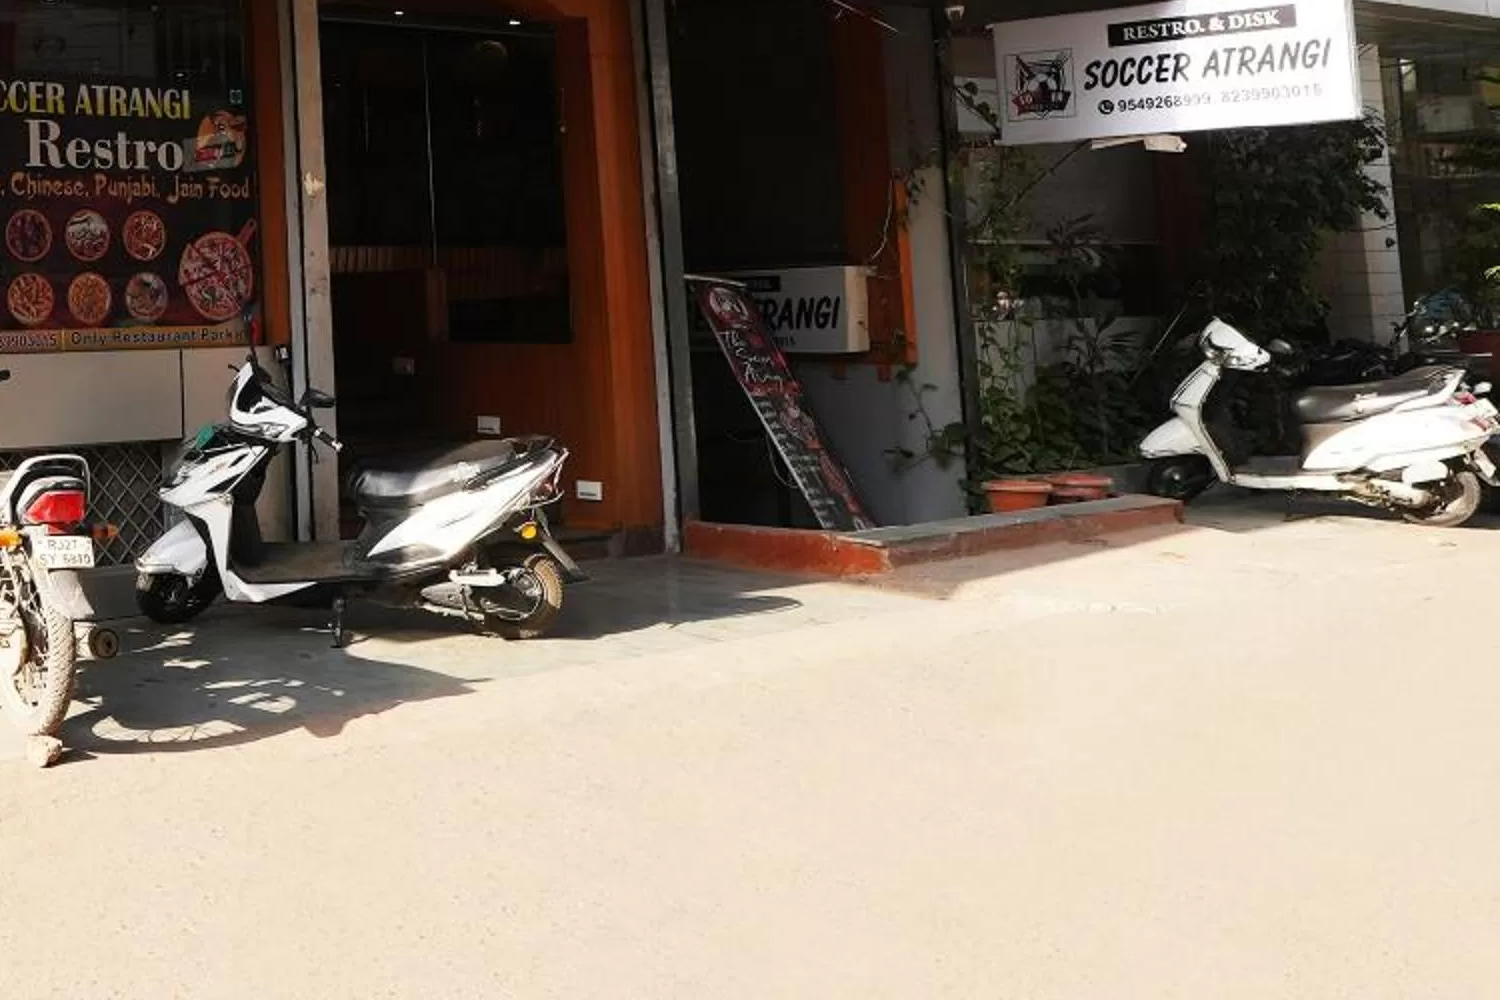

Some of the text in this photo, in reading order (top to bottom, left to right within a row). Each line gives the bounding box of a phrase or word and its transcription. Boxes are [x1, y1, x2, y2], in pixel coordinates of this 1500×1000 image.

[1208, 17, 1225, 33] &
[1227, 9, 1281, 30] DISK
[1083, 38, 1332, 91] SOCCER ATRANGI
[75, 84, 191, 119] ATRANGI
[25, 118, 183, 173] Restro
[167, 176, 201, 203] Jain
[207, 176, 250, 199] Food
[754, 296, 841, 330] RANGI
